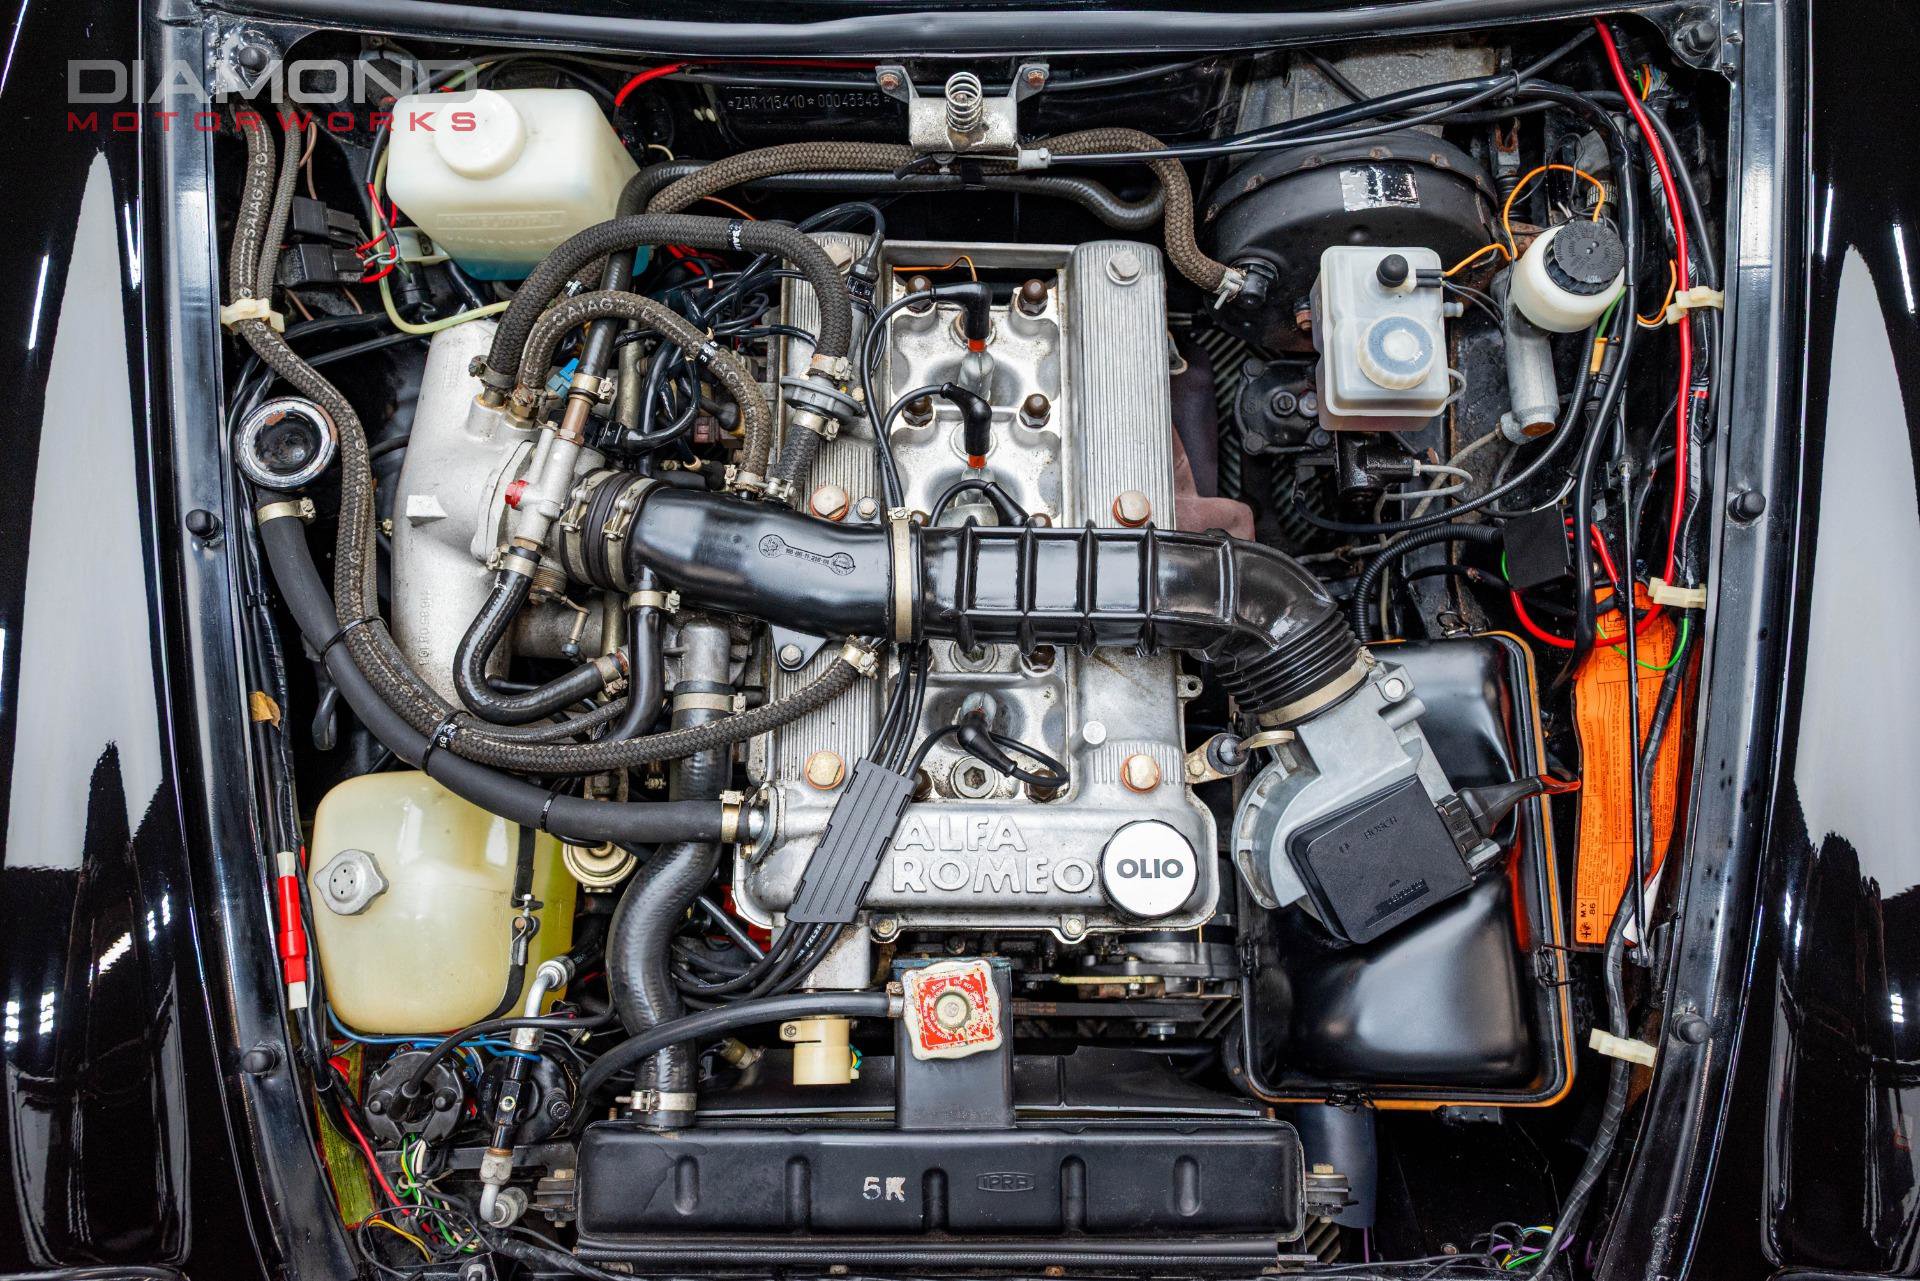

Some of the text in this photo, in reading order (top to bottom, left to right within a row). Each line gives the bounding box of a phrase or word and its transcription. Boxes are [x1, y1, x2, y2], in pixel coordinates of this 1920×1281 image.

[894, 815, 1028, 852] ALFA
[892, 856, 1095, 893] ROMEO
[1116, 858, 1185, 879] OLIO
